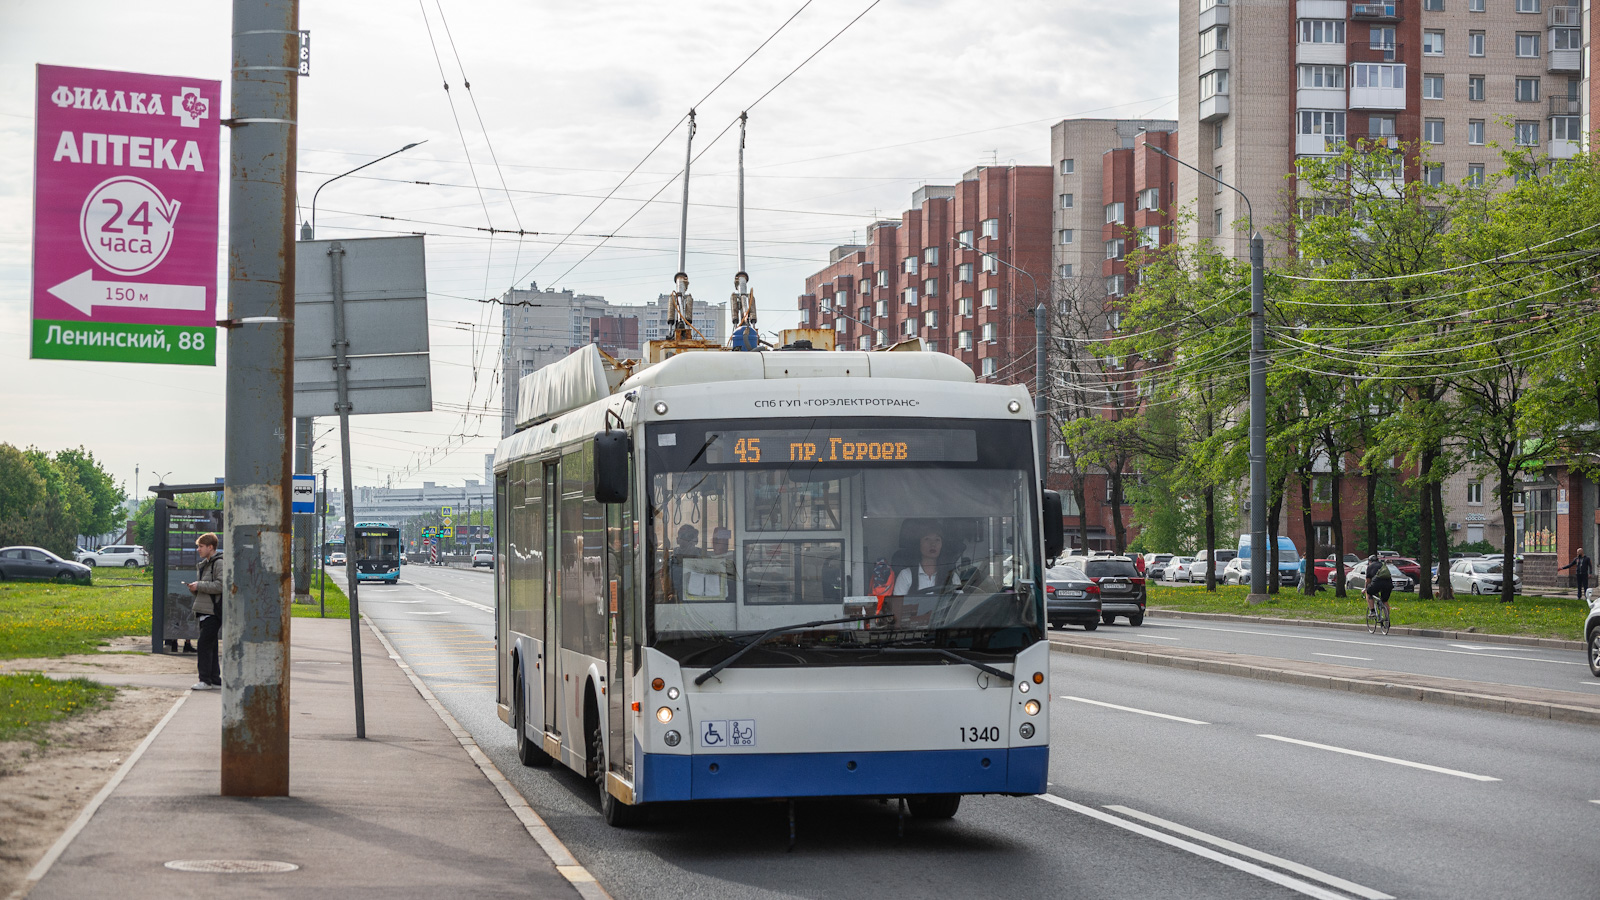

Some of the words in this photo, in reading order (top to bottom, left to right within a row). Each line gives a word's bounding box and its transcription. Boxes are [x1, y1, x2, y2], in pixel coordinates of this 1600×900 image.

[51, 85, 165, 115] ФИАЛКА
[53, 131, 204, 172] АПТЕКА
[101, 198, 153, 235] 24
[100, 236, 153, 254] часа
[105, 287, 135, 302] 150
[139, 293, 149, 302] м
[45, 325, 171, 352] Ленинский,
[178, 332, 205, 350] 88
[778, 399, 801, 408] ГУП
[734, 437, 762, 463] 45
[960, 726, 999, 742] 1340
